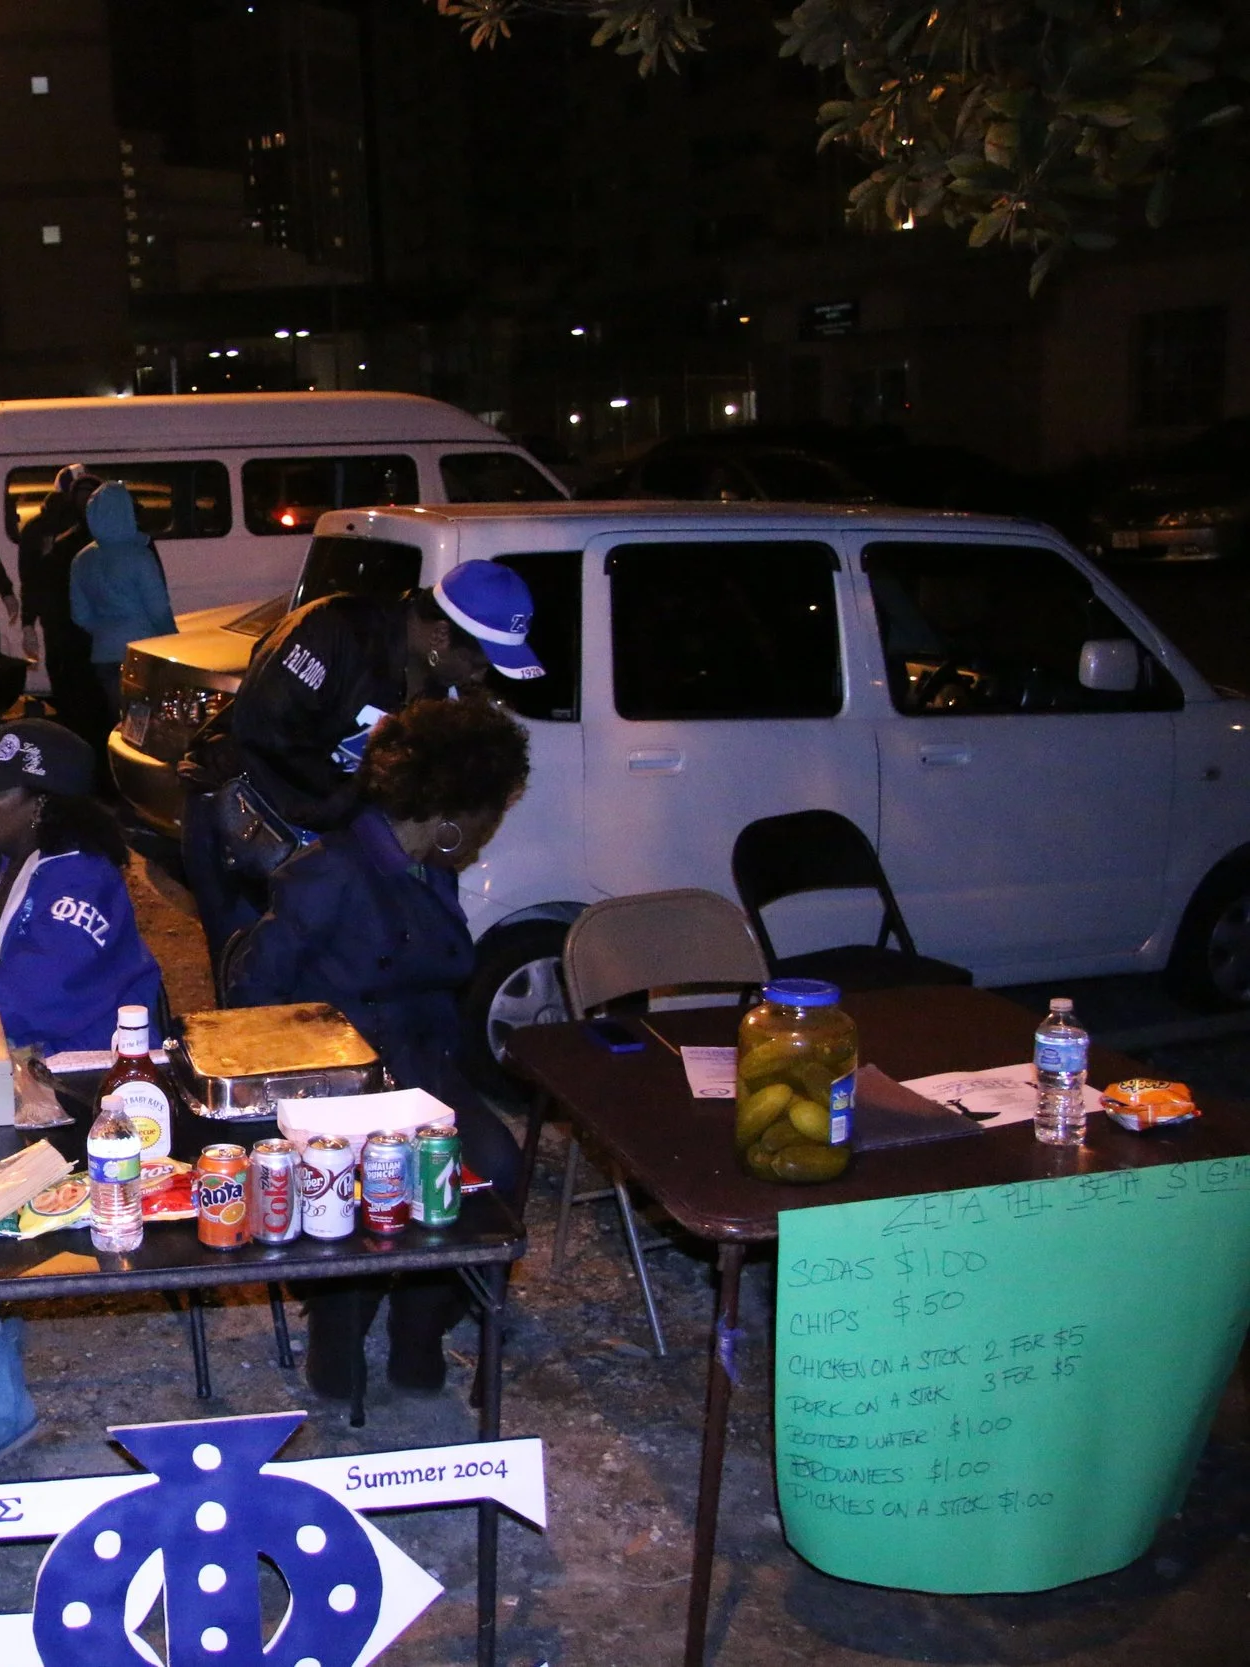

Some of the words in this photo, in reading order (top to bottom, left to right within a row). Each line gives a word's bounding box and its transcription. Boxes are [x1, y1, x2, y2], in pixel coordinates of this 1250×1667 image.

[282, 643, 311, 675] Fall
[298, 657, 327, 691] 2009
[520, 666, 543, 680] 1920
[367, 1170, 395, 1180] PUNCH
[263, 1167, 289, 1233] Coke
[882, 1191, 985, 1232] ZETA
[1068, 1171, 1140, 1202] BETA
[787, 1257, 875, 1288] SODAS
[894, 1242, 987, 1282] $1.00
[892, 1289, 965, 1327] $.50
[788, 1354, 866, 1382] CHICKEN
[870, 1358, 893, 1377] ON
[901, 1355, 910, 1373] A
[984, 1339, 1000, 1362] 2
[1053, 1325, 1088, 1352] $5
[785, 1395, 849, 1418] PORK
[854, 1396, 879, 1415] ON
[890, 1392, 900, 1408] A
[981, 1372, 997, 1393] 3
[1051, 1355, 1082, 1382] $5
[948, 1414, 1012, 1441] $1.00
[346, 1465, 446, 1490] Summer
[453, 1459, 508, 1479] 2004
[927, 1457, 991, 1487] $1.00
[882, 1500, 908, 1518] ON
[917, 1499, 928, 1516] A
[998, 1487, 1054, 1515] $1.00
